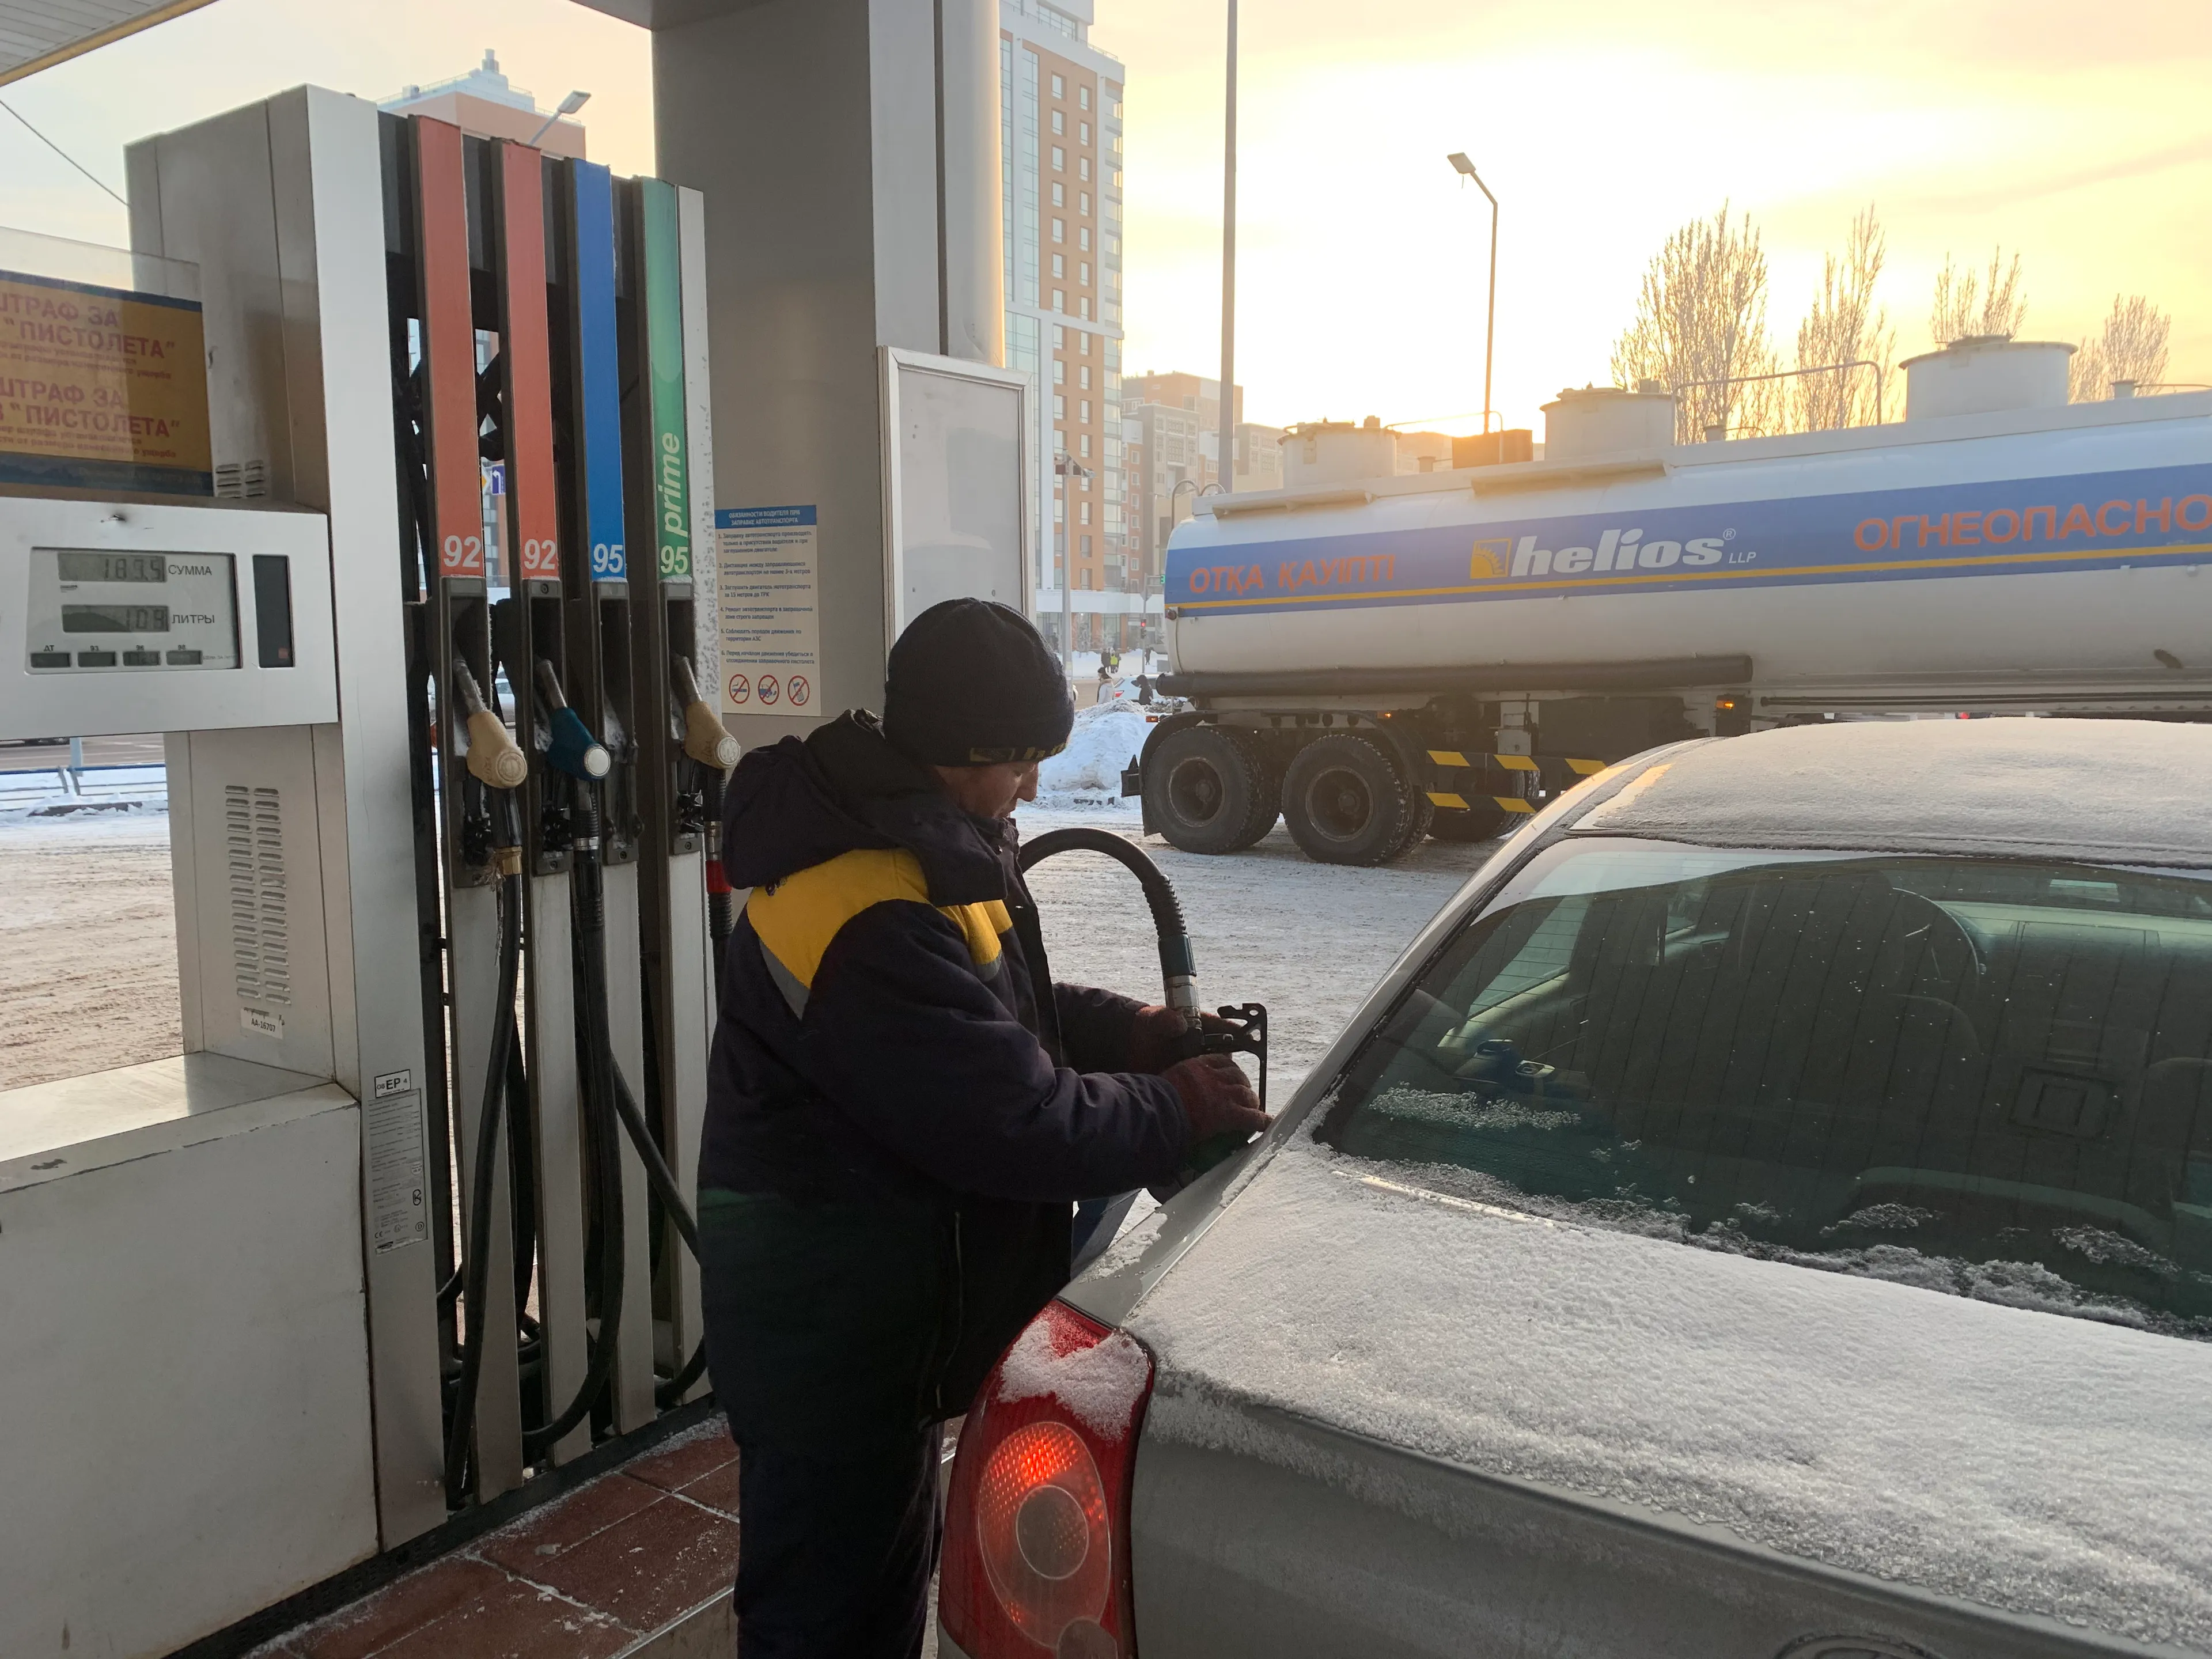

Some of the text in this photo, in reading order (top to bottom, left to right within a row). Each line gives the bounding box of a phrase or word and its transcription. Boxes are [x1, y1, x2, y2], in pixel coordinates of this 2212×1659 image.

[88, 305, 119, 328] ЗА
[93, 387, 126, 409] ЗА
[658, 432, 688, 538] prime
[444, 535, 481, 568] 92
[524, 539, 556, 570] 92
[593, 543, 623, 574] 95
[661, 545, 688, 574] 95
[1729, 551, 1756, 564] LLP
[168, 565, 212, 575] СУММА
[1189, 554, 1396, 596] ОТҚА ҚАУІПТІ
[172, 615, 215, 624] ЛИТРЫ
[386, 1078, 400, 1090] EP
